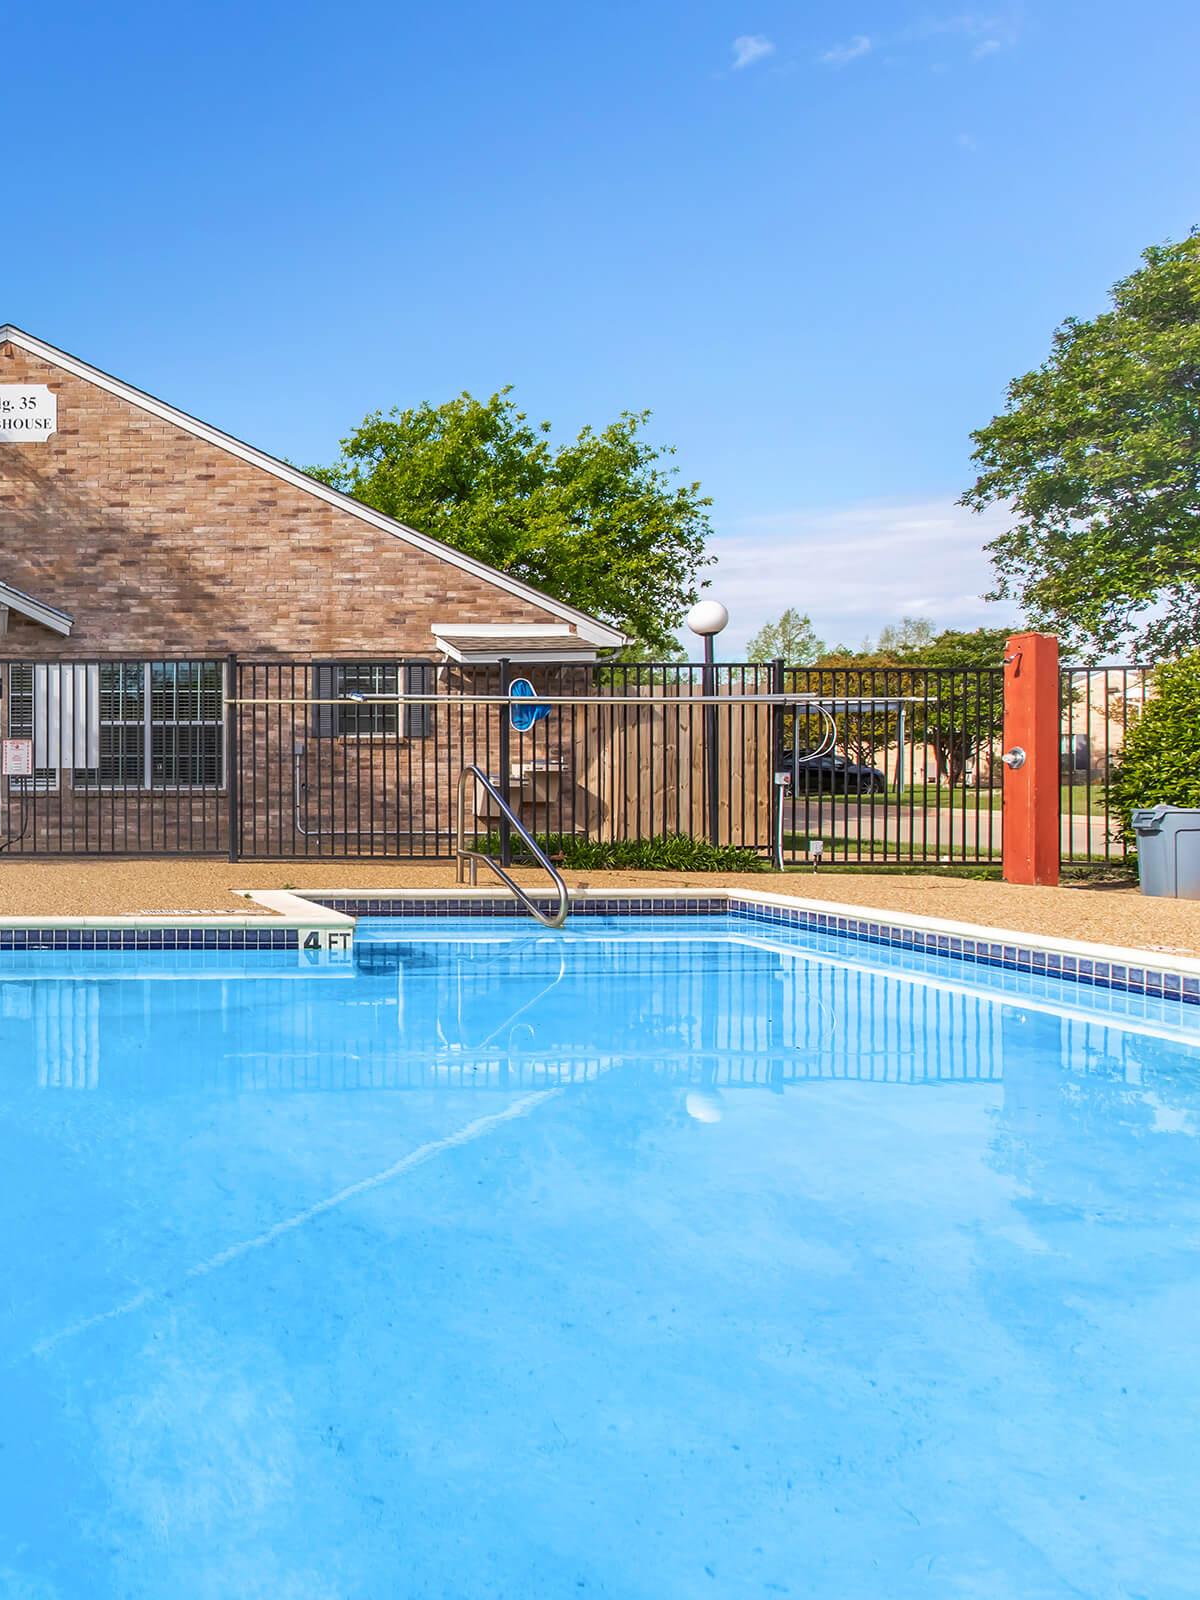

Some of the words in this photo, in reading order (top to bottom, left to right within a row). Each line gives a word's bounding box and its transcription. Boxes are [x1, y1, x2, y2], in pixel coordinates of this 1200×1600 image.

[20, 396, 37, 410] 35
[304, 931, 322, 950] 4
[328, 933, 351, 950] FT
